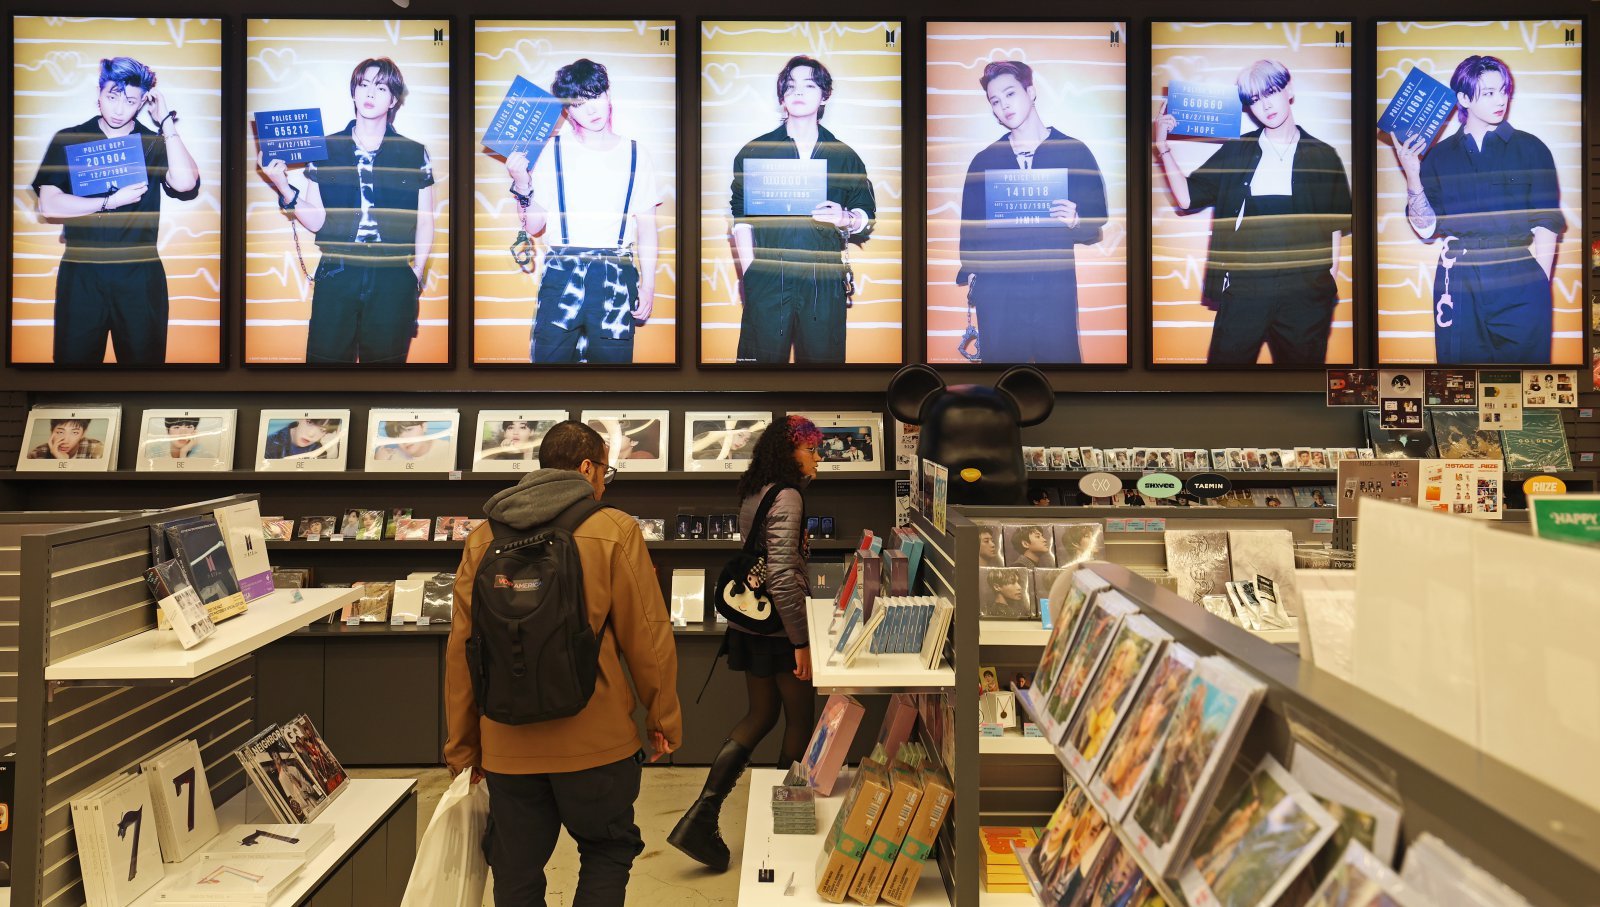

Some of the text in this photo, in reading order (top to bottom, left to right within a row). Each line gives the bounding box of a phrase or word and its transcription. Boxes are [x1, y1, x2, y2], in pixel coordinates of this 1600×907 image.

[1389, 82, 1415, 117] POLICE DEPT
[1400, 89, 1427, 123] 110604
[271, 113, 308, 122] POLICE DEPT
[494, 92, 519, 132] POLICE DEPT
[505, 100, 531, 138] 384627
[1424, 100, 1452, 139] JUNG KOOK
[274, 125, 309, 136] 655212
[535, 122, 551, 142] SUGA
[1187, 125, 1215, 135] J-HOPE
[83, 141, 125, 153] POLICE DEPT
[86, 152, 126, 167] 201904
[290, 152, 302, 160] JIN
[1006, 186, 1049, 197] 141018
[1091, 478, 1111, 492] EXO
[1532, 482, 1558, 492] RIIZE
[513, 581, 542, 589] AMERICA
[283, 724, 304, 744] GQ
